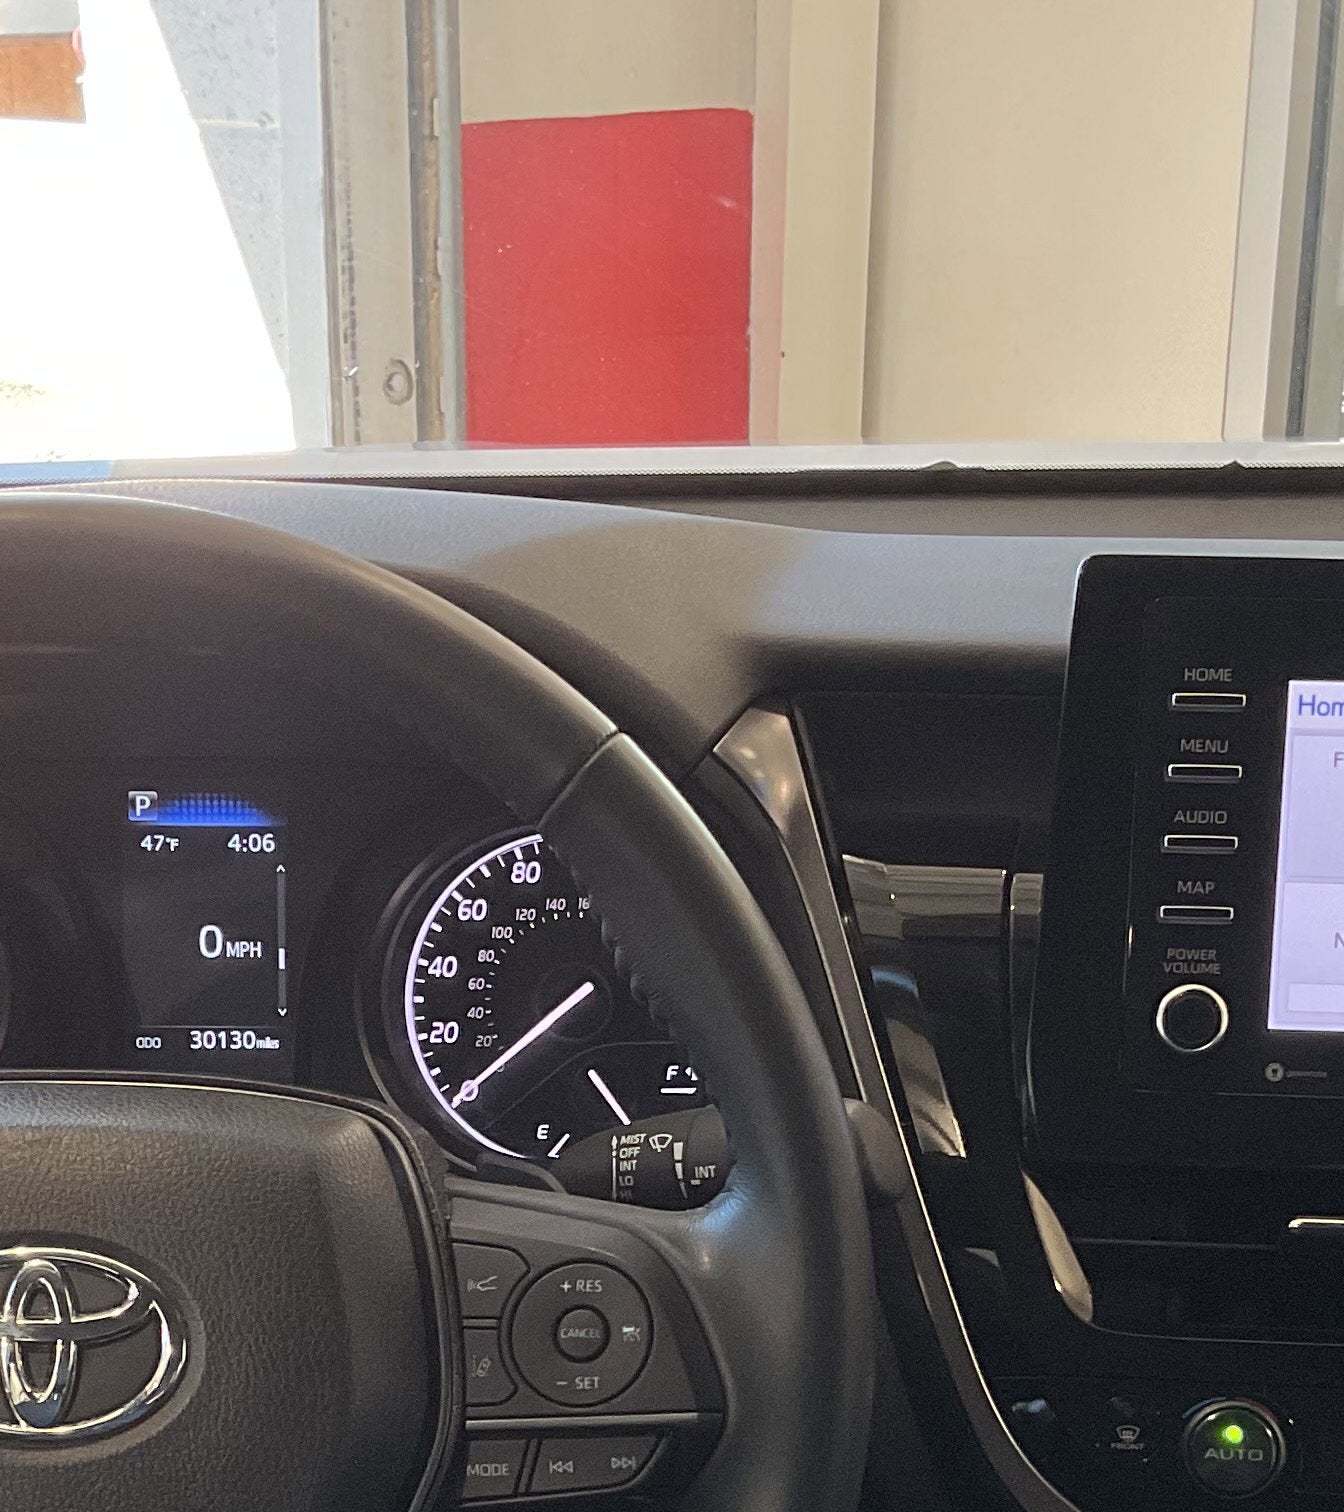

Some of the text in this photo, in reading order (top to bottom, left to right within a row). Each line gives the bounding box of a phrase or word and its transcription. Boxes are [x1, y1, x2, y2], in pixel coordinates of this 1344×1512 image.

[1184, 668, 1233, 683] HOME
[1180, 739, 1229, 754] MENU
[135, 795, 152, 817] P
[1174, 809, 1228, 825] AUDIO
[227, 833, 276, 853] 4:06
[511, 861, 542, 884] 80
[1177, 880, 1215, 895] MAP
[456, 898, 488, 921] 60
[545, 898, 566, 911] 140
[515, 908, 536, 921] 120
[491, 926, 513, 940] 100
[199, 924, 262, 959] 0 MPH
[477, 950, 495, 963] 80
[1167, 948, 1217, 962] POWER
[428, 956, 457, 978] 40
[1163, 961, 1221, 976] VOLUME
[468, 978, 485, 991] 60
[467, 1006, 484, 1020] 40
[429, 1021, 459, 1044] 20
[135, 1036, 162, 1050] ODO
[190, 1030, 256, 1050] 30130
[475, 1035, 493, 1048] 20
[665, 1066, 679, 1080] F
[536, 1124, 549, 1140] E
[620, 1133, 647, 1146] MIST
[619, 1146, 641, 1159] OFF
[619, 1160, 637, 1172] INT
[694, 1165, 716, 1179] INT
[619, 1175, 634, 1187] LO
[575, 1279, 603, 1293] RES
[574, 1377, 601, 1390] SET
[1204, 1447, 1264, 1461] AUTO
[466, 1463, 510, 1477] MODE
